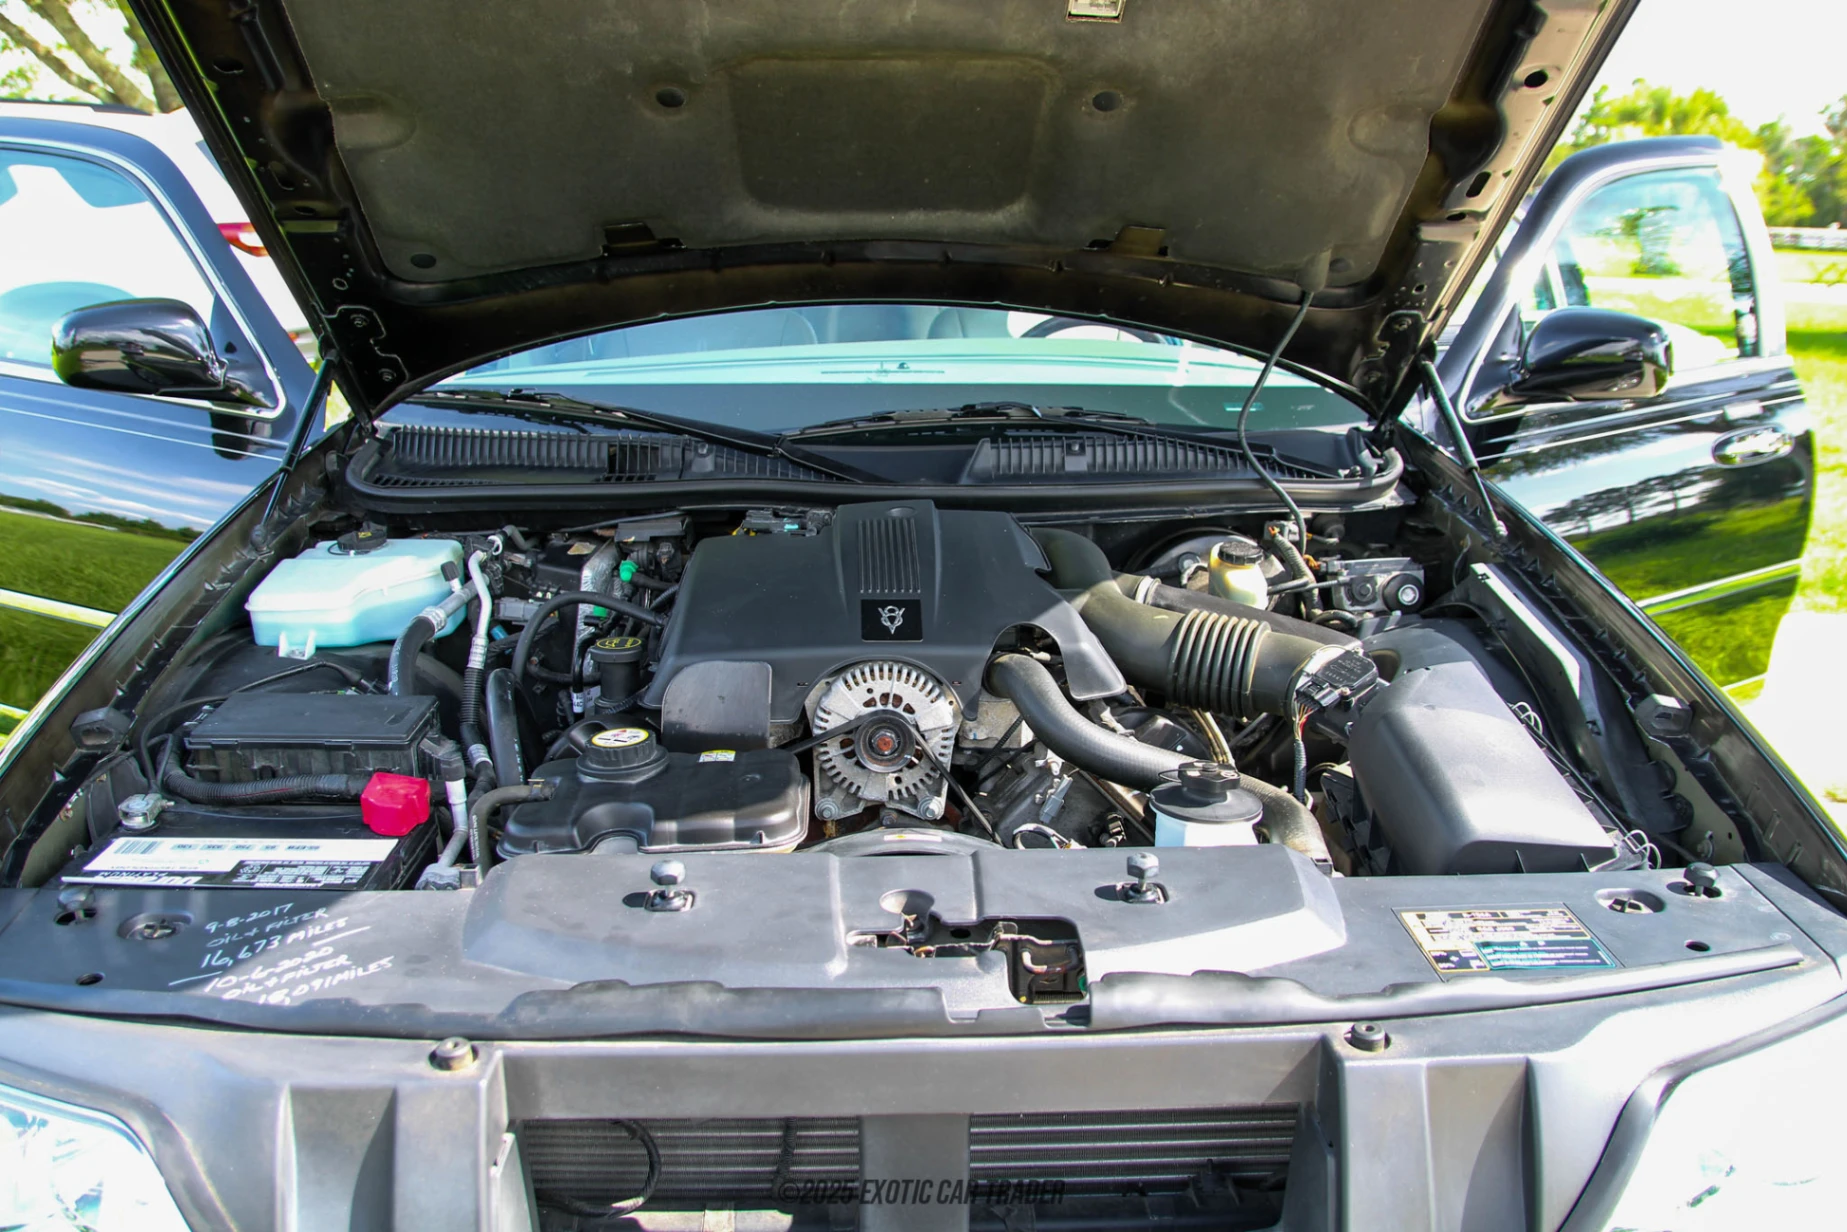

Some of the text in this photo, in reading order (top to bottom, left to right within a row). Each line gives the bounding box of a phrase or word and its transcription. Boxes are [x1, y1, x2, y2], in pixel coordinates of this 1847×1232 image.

[204, 902, 295, 934] 9-8-2017
[200, 934, 283, 969] 16,673
[204, 945, 335, 993] 10-6-2020
